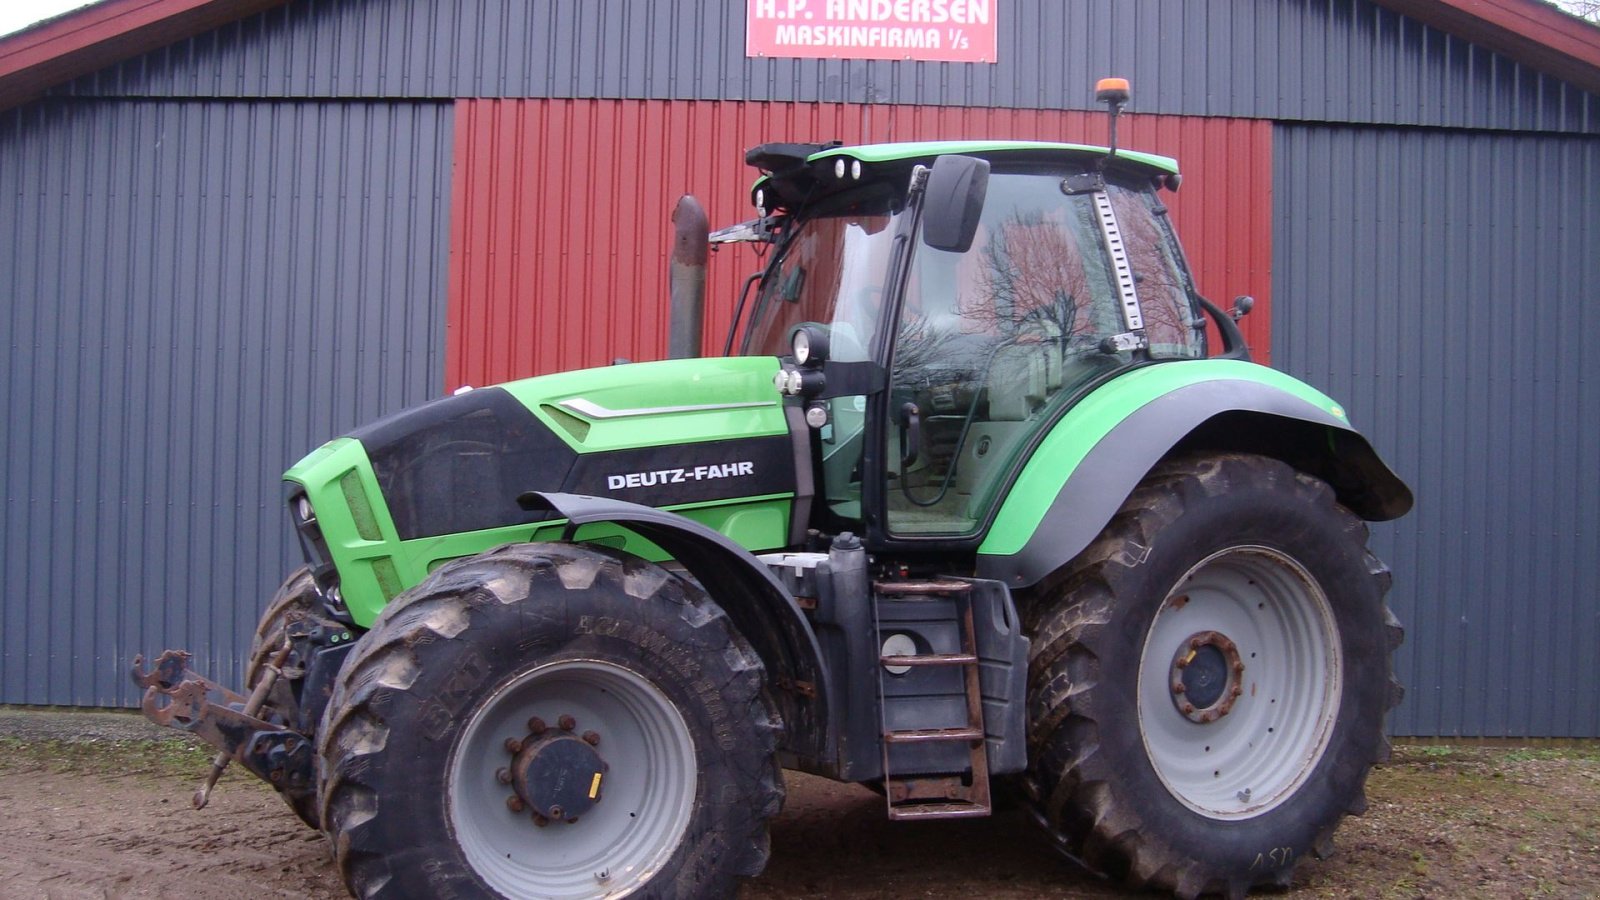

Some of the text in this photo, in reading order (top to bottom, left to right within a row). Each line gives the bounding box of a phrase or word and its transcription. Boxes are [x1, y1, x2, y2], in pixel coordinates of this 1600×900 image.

[756, 0, 989, 24] H.P. ANDERSEN
[775, 25, 941, 48] MASKINFIRMA
[608, 461, 754, 490] DEUTZ-FAHR
